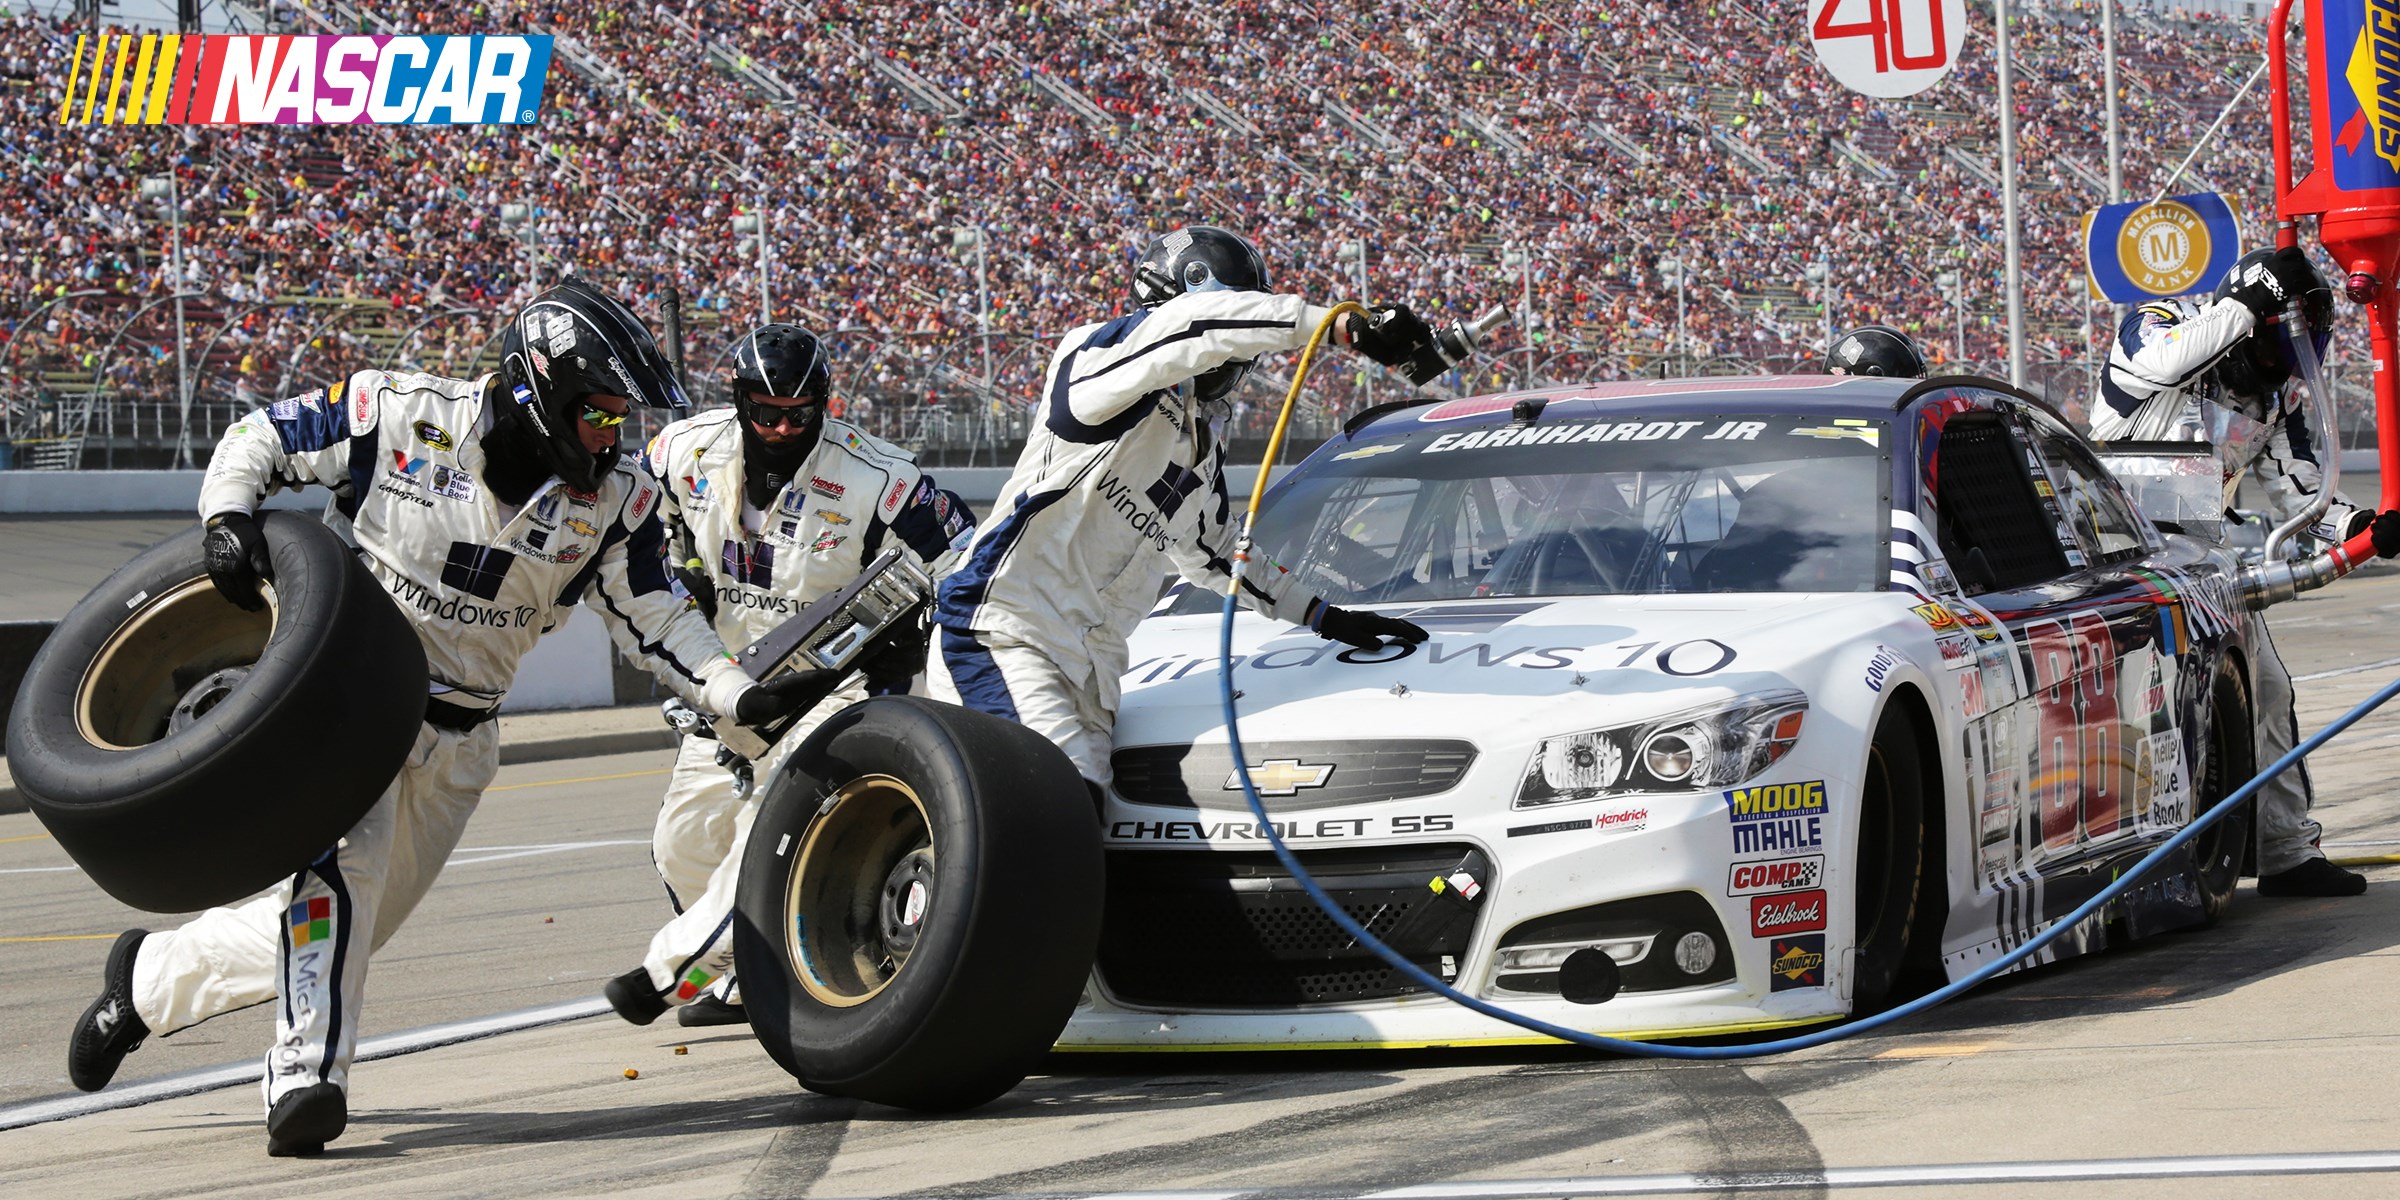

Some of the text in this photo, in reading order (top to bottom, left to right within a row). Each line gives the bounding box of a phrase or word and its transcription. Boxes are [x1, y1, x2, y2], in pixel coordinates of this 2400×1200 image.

[1813, 0, 1947, 73] 40
[2127, 209, 2195, 238] MEDALLION
[2150, 232, 2179, 263] M
[2142, 266, 2194, 288] BANK
[546, 312, 577, 358] 88
[358, 388, 369, 422] SIMPSON
[527, 404, 549, 437] Nationwide
[1420, 420, 1768, 455] EARNHARDT JR
[857, 445, 894, 467] Microsoft
[388, 470, 422, 489] Valvoline
[450, 481, 470, 493] Blue
[810, 475, 846, 496] Hendrick
[378, 484, 434, 508] GOODYEAR
[448, 489, 470, 502] Book
[632, 486, 652, 518] SIMPSON
[887, 482, 904, 510] SIMPSON
[1096, 469, 1169, 552] Windows
[510, 537, 557, 564] Windows 10
[393, 573, 537, 628] Windows 10
[716, 586, 789, 614] ndows
[1617, 638, 1738, 677] 10
[1960, 670, 1986, 717] 3M
[2024, 609, 2121, 856] 88
[2154, 738, 2182, 766] Kelley
[2153, 770, 2179, 798] Blue
[1733, 782, 1823, 815] MOOG
[1782, 808, 1821, 817] SUSPENSION
[2153, 797, 2184, 826] Book
[1111, 814, 1454, 840] CHEVROLET SS
[1544, 824, 1568, 833] NSCS
[1596, 808, 1648, 828] Hendrick
[1733, 817, 1822, 854] MAHLE
[1799, 846, 1823, 854] BEARINGS
[1734, 862, 1802, 889] COMP
[1781, 877, 1811, 888] CAMS
[1757, 900, 1819, 928] Edelbrock
[1775, 954, 1820, 972] SUNOCO
